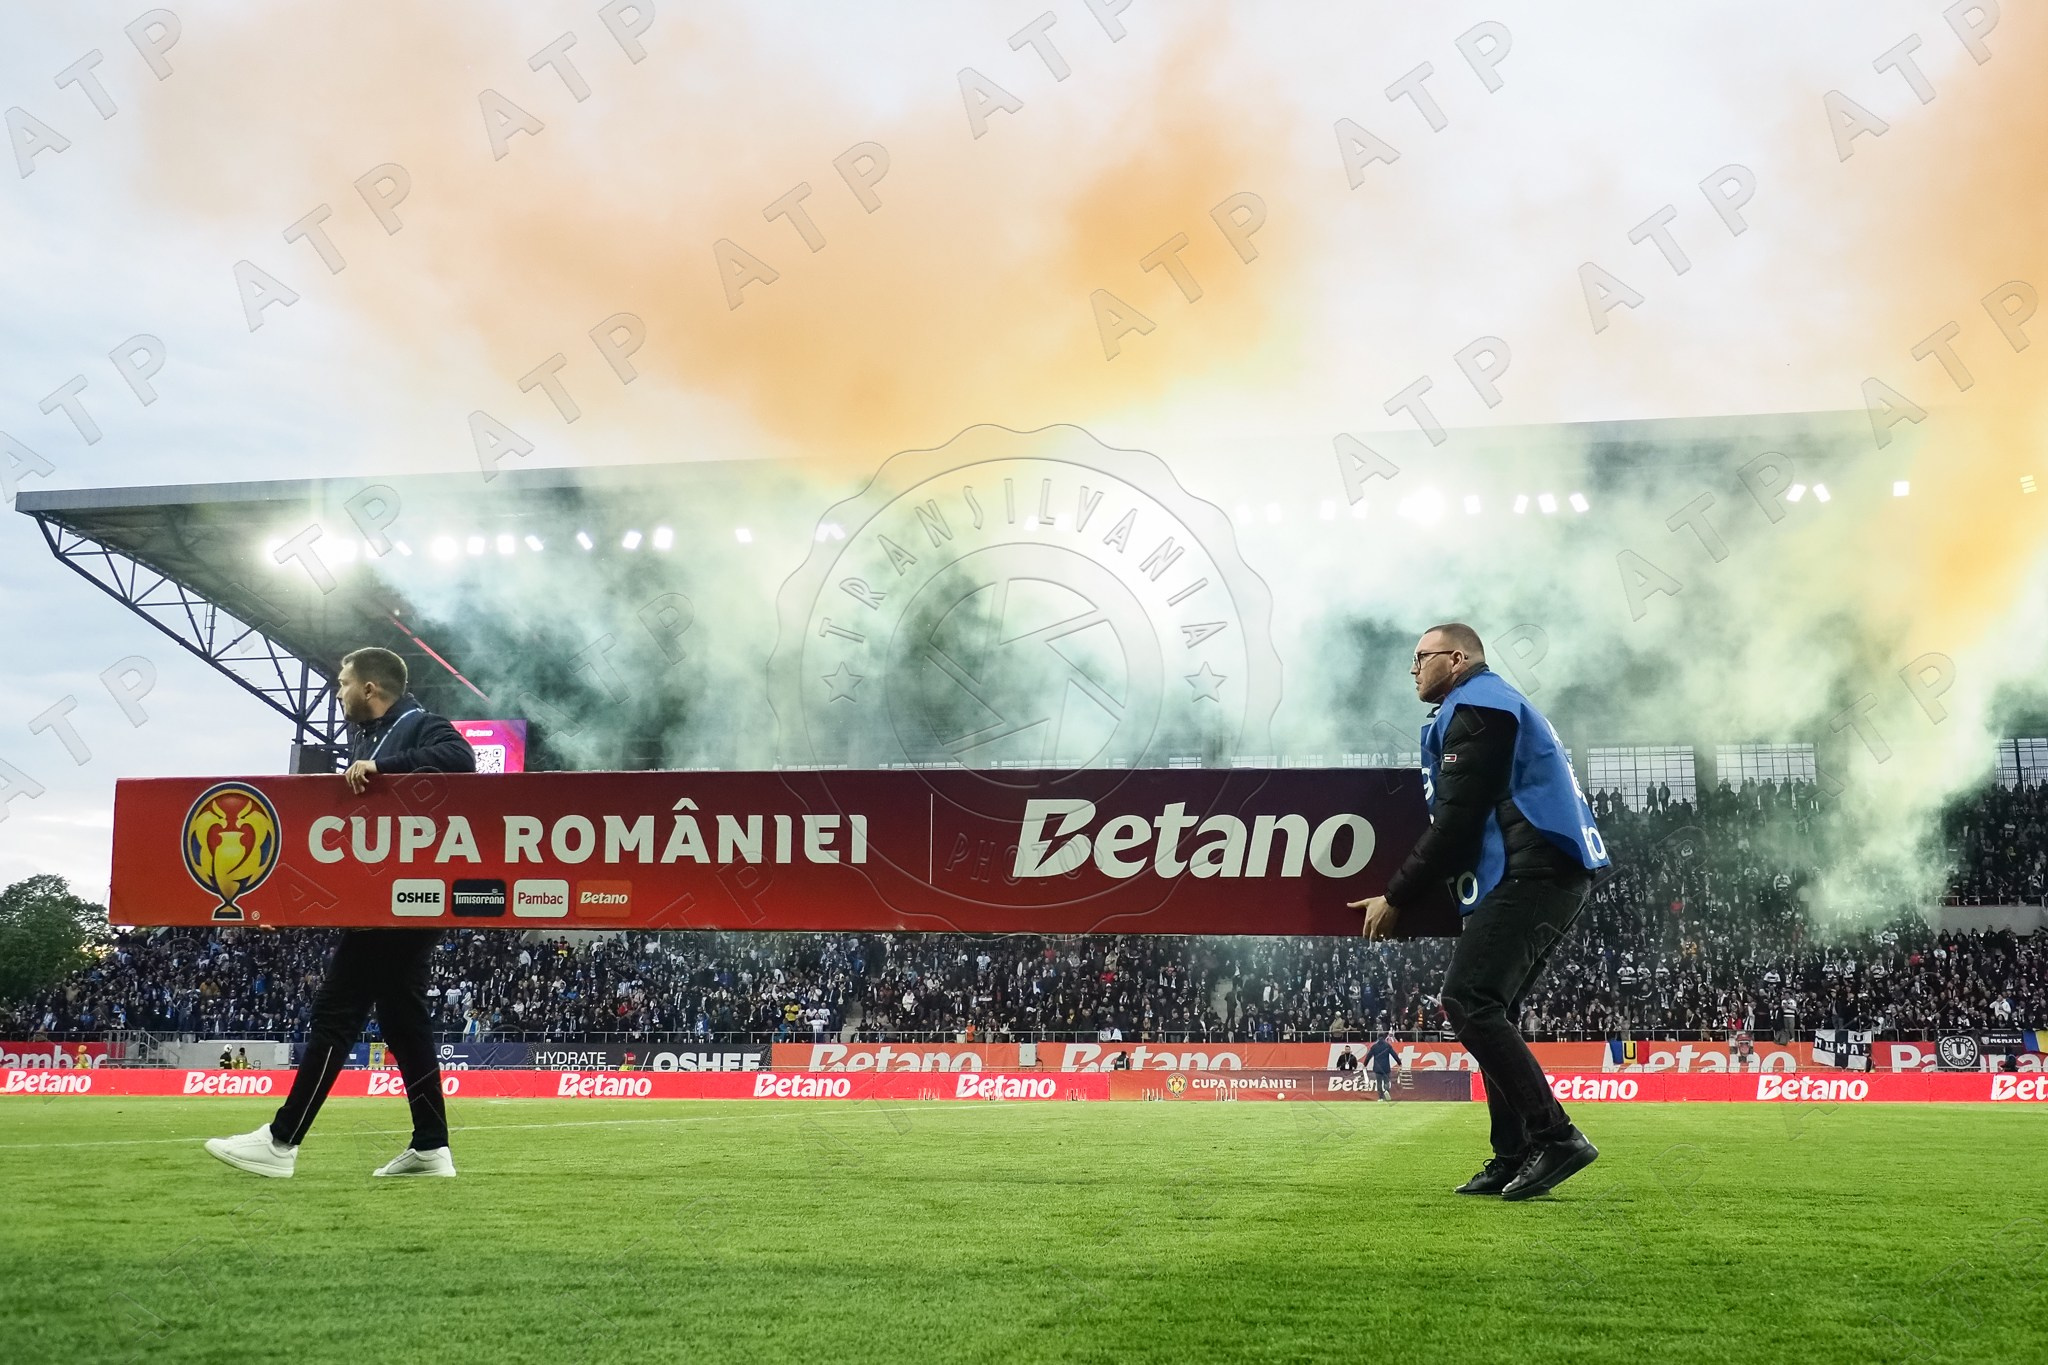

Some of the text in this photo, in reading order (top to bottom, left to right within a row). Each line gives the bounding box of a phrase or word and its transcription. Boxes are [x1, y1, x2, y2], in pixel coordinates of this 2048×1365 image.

[309, 797, 868, 864] CUPA ROMÂNIEI
[1012, 799, 1376, 879] Betano
[396, 891, 441, 904] OSHEE
[517, 891, 564, 905] Pambac
[580, 891, 629, 905] Betano
[0, 1045, 107, 1069] ambc
[535, 1051, 607, 1065] HYDRATE
[1624, 1042, 1636, 1060] U
[1951, 1043, 1966, 1060] U
[5, 1071, 92, 1093] Betano
[183, 1071, 273, 1094] Betano
[557, 1073, 652, 1097] Betano
[753, 1073, 851, 1098] Betano
[955, 1074, 1056, 1098] Betano
[1192, 1076, 1297, 1089] CUPA ROMÂNIEI
[1756, 1075, 1869, 1100] Betano
[1990, 1075, 2048, 1101] Bet
